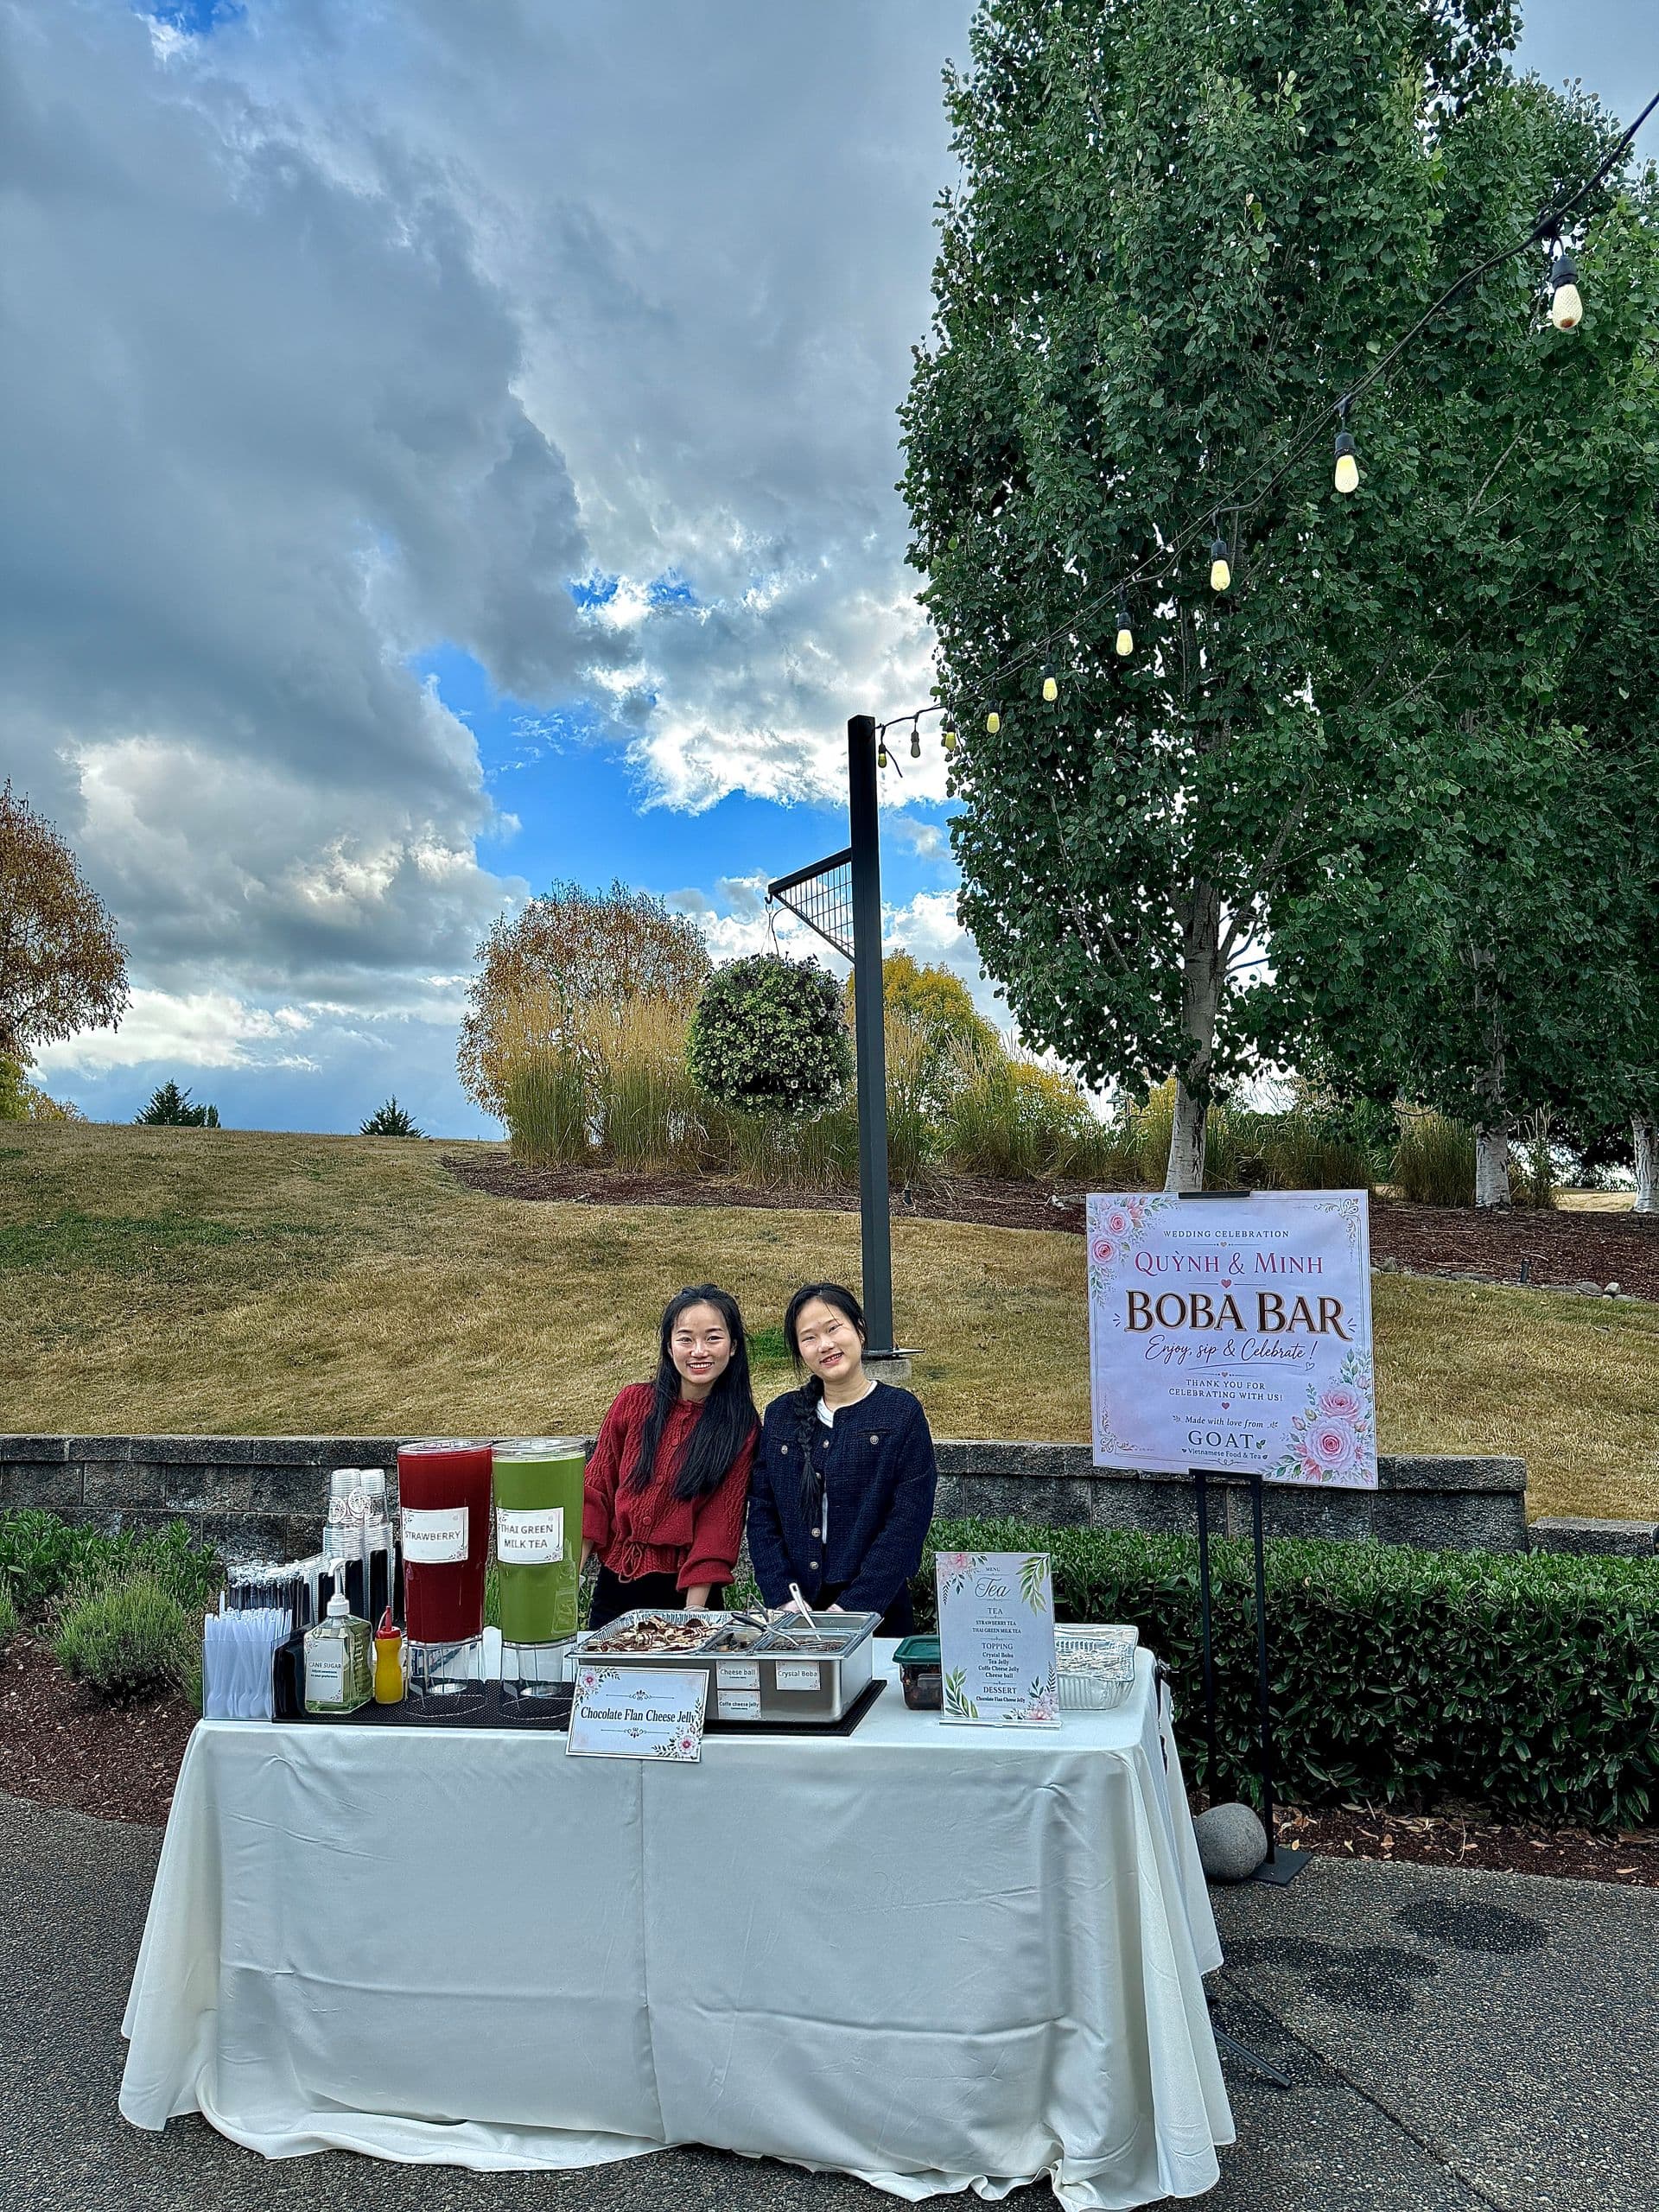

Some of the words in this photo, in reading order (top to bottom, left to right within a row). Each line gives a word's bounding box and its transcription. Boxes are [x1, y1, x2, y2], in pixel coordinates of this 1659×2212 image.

[1228, 1252, 1245, 1275] &
[1255, 1252, 1323, 1274] MINH
[1124, 1290, 1247, 1333] BOBA
[1255, 1291, 1354, 1342] BAR
[1145, 1334, 1192, 1365] Enjoy,
[1196, 1344, 1217, 1363] sip
[1223, 1338, 1236, 1357] &
[1185, 1379, 1220, 1388] THANK
[1169, 1388, 1236, 1399] CELEBRATING
[1239, 1392, 1264, 1401] WITH
[1208, 1417, 1224, 1426] with
[1243, 1419, 1263, 1428] from
[1188, 1430, 1254, 1449] GOAT
[1188, 1448, 1224, 1457] Vietnamese
[500, 1524, 518, 1533] THAI
[521, 1524, 553, 1533] GREEN
[404, 1530, 461, 1541] STRAWBERRY
[505, 1539, 525, 1548] MILK
[528, 1539, 548, 1548] TEA
[975, 1577, 1011, 1598] Tea
[778, 1670, 800, 1679] Crystal
[581, 1707, 622, 1720] Chocolate
[624, 1708, 643, 1721] Flan
[645, 1710, 675, 1723] Cheese
[677, 1711, 696, 1724] Jelly
